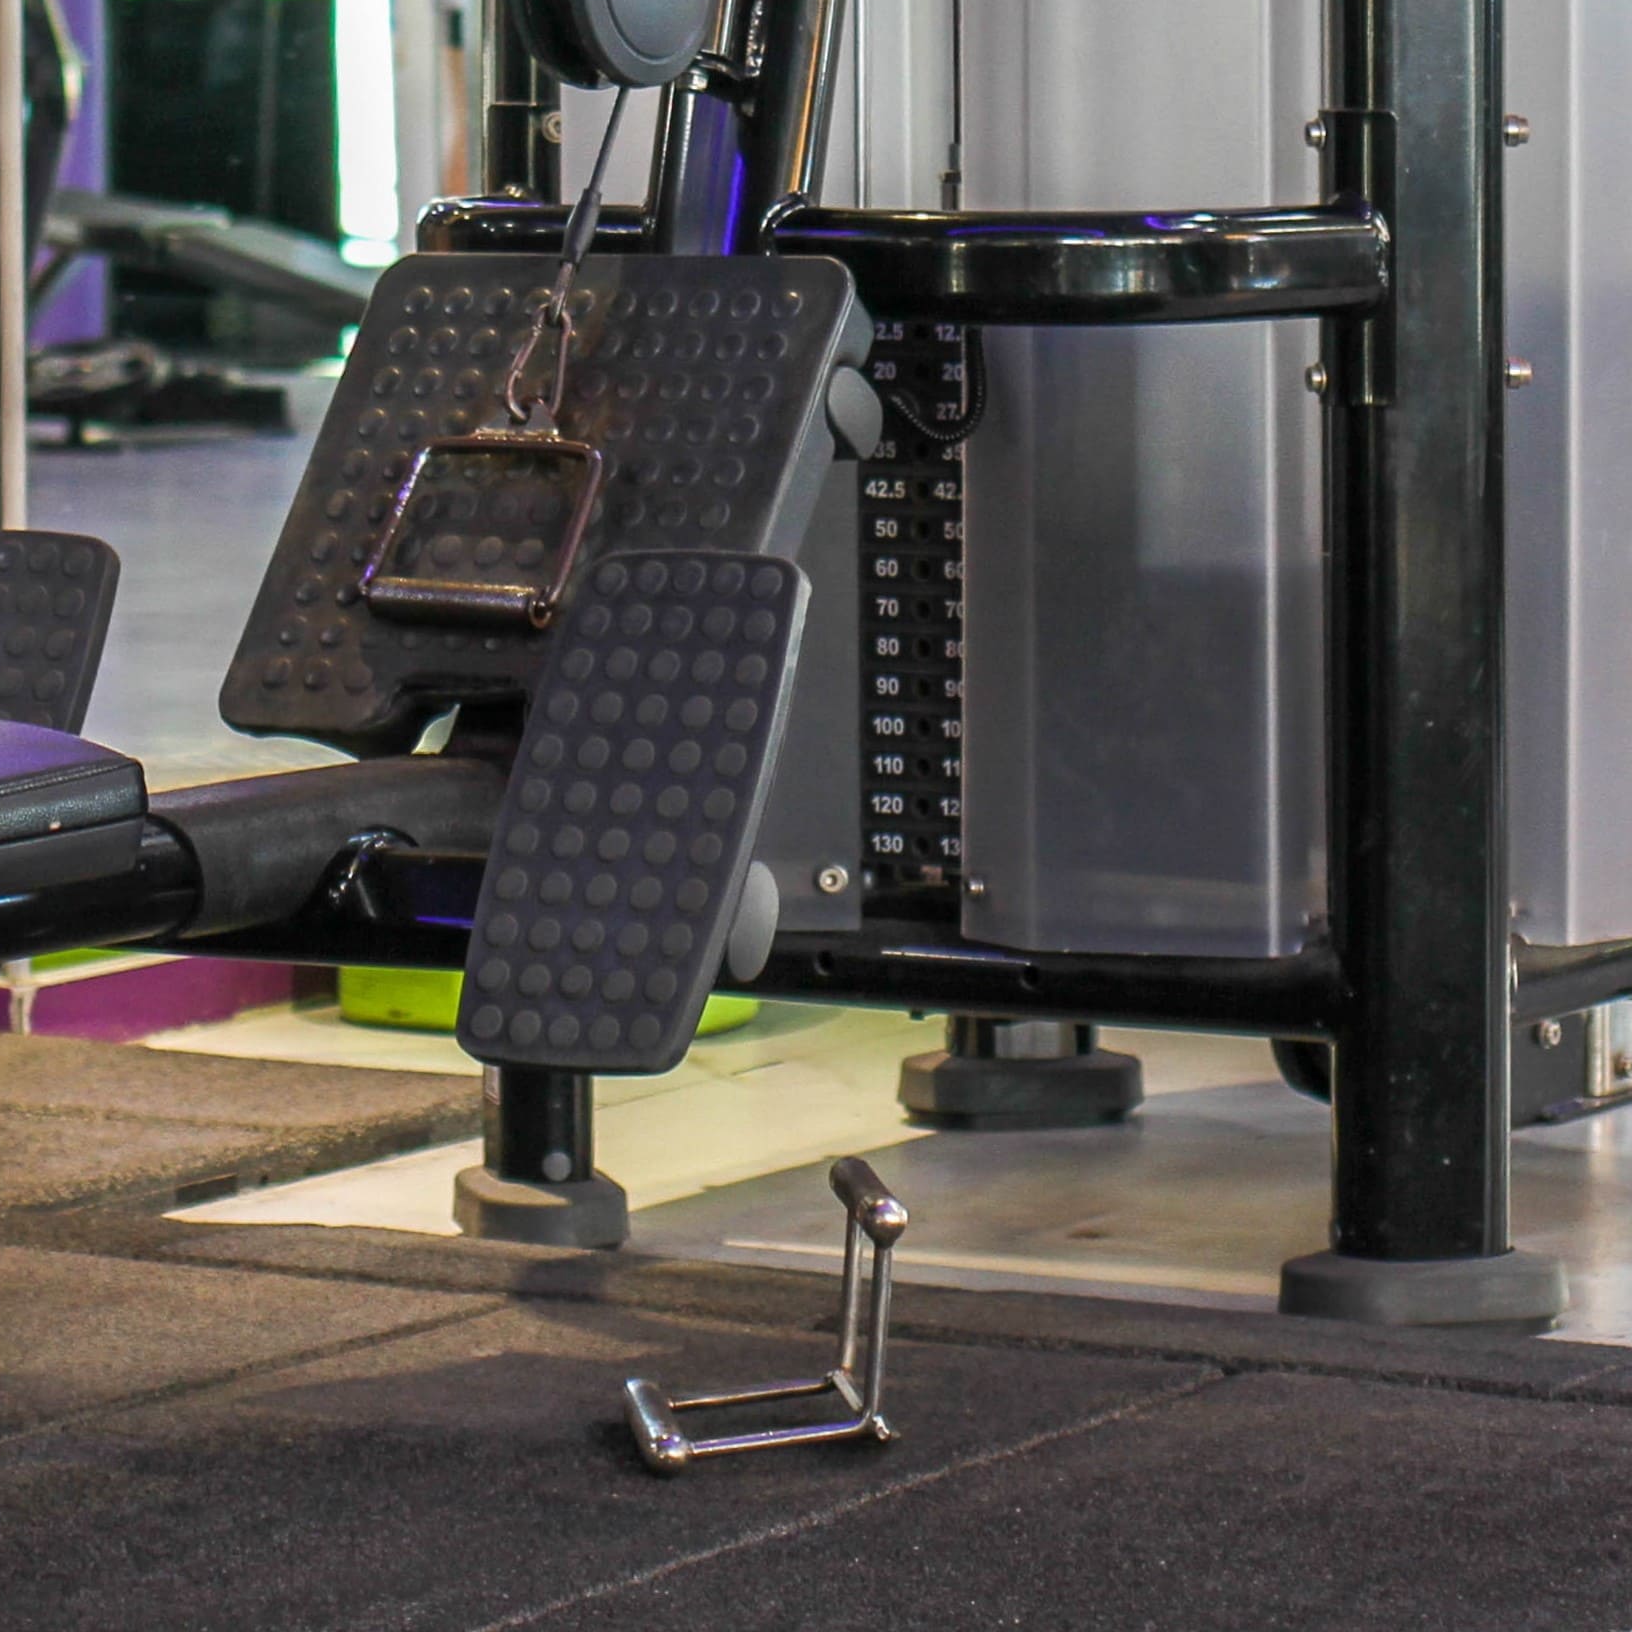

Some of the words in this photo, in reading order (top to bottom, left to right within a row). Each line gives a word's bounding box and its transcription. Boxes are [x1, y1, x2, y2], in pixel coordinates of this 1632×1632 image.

[875, 323, 904, 341] 2.5
[934, 324, 962, 342] 12.
[874, 362, 897, 380] 20
[935, 402, 961, 420] 27.
[865, 480, 906, 498] 42.5
[933, 482, 963, 500] 42.
[875, 520, 898, 538] 50
[875, 559, 899, 577] 60
[876, 598, 899, 616] 70
[876, 638, 900, 656] 80
[875, 677, 900, 695] 90
[873, 717, 904, 736] 100
[873, 756, 904, 775] 110
[871, 795, 904, 814] 120
[872, 834, 904, 853] 130
